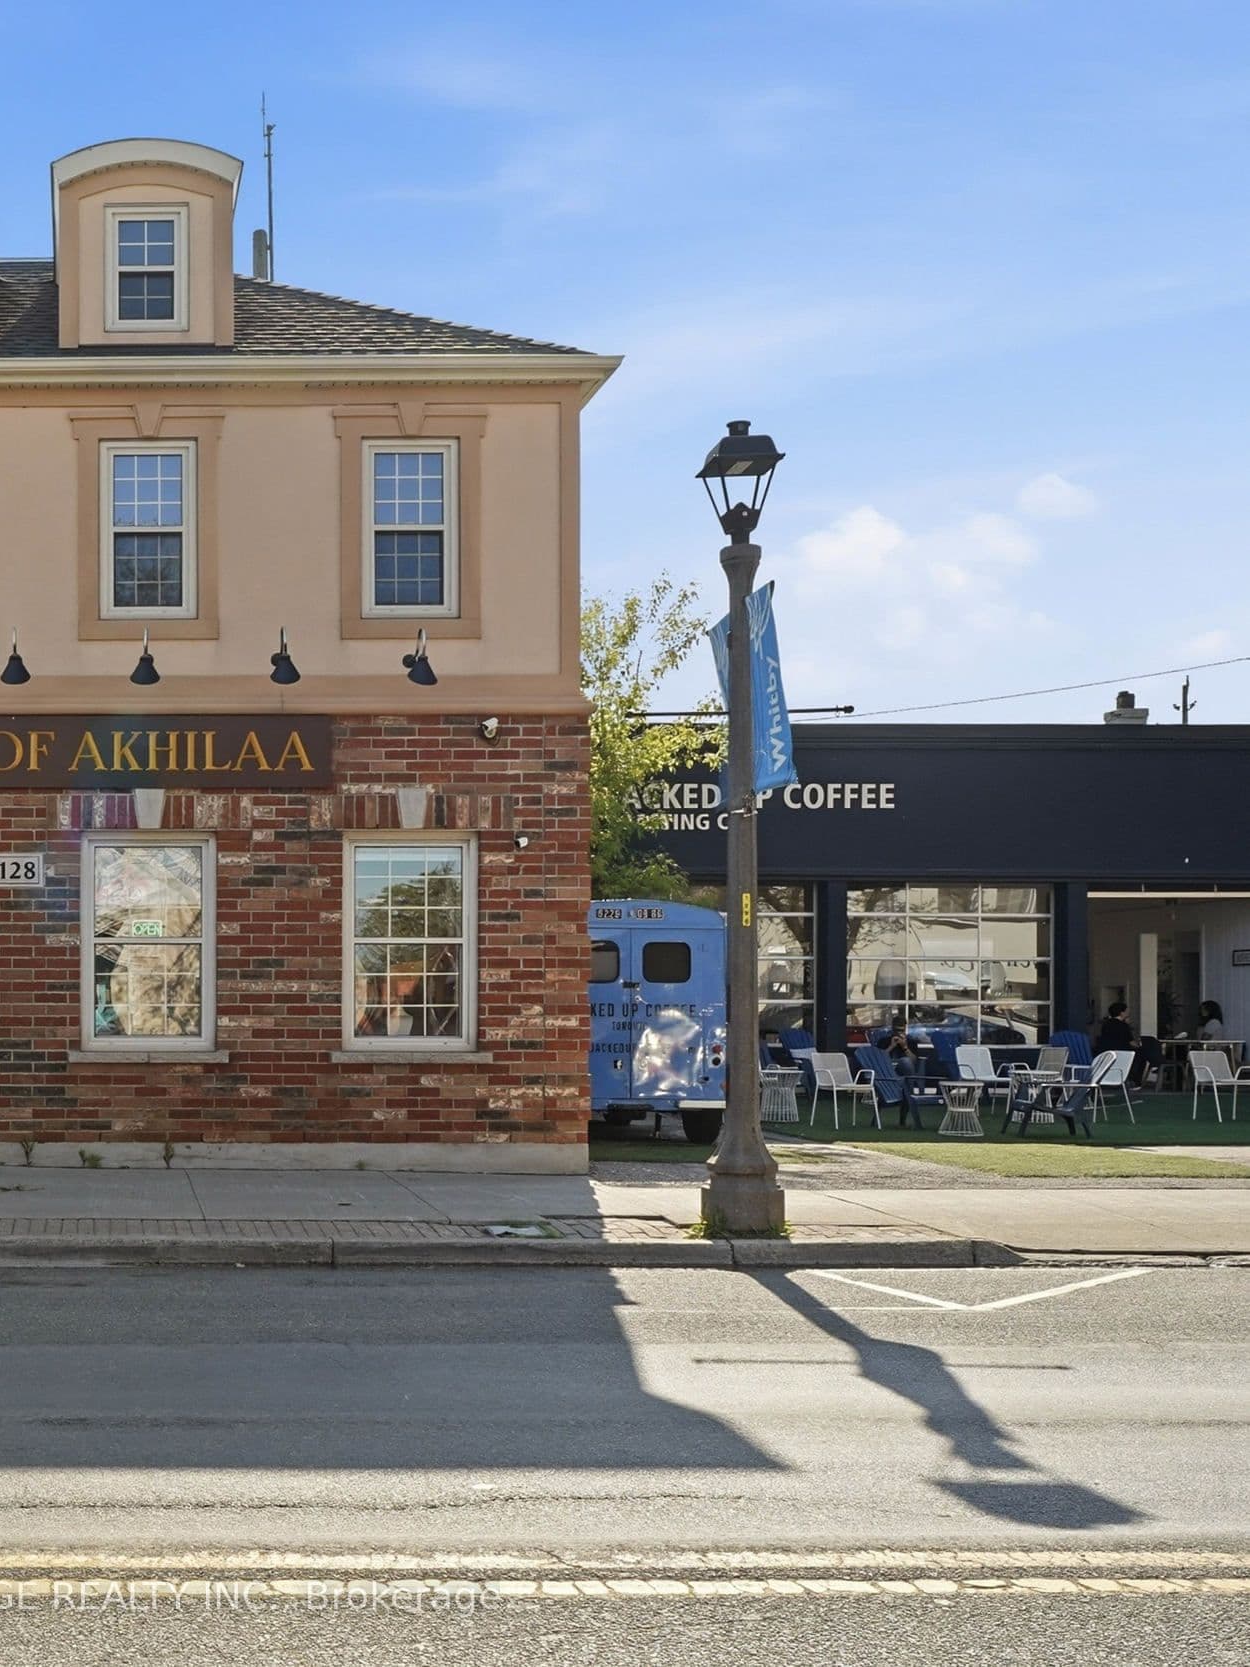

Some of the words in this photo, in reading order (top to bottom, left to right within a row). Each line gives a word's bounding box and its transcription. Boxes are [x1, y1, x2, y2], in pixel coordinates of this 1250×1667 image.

[766, 656, 787, 774] Whitby
[68, 731, 315, 772] AKHILAA
[783, 783, 895, 809] COFFEE
[0, 861, 36, 880] 128
[622, 1003, 638, 1017] UP
